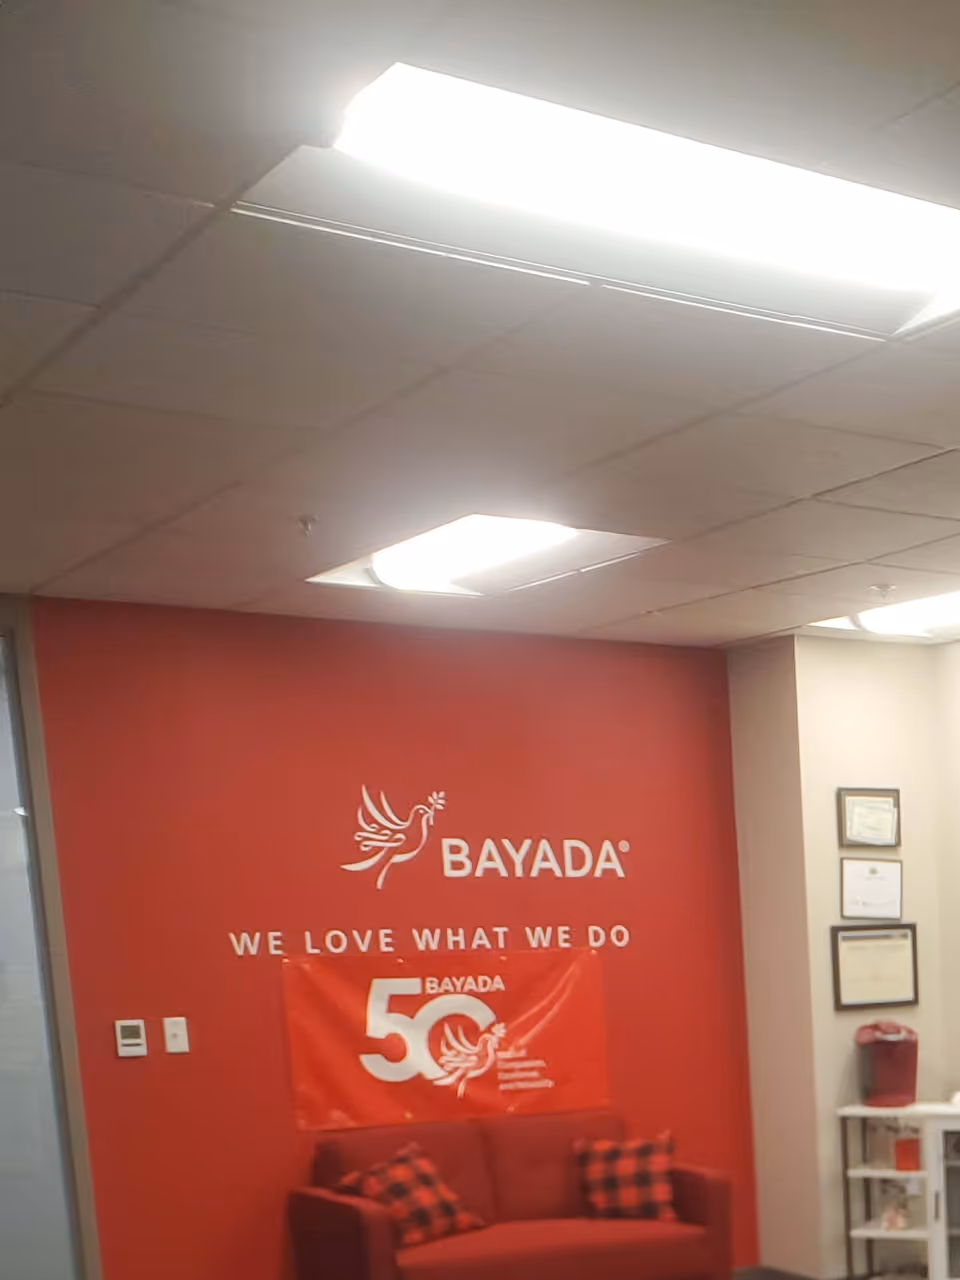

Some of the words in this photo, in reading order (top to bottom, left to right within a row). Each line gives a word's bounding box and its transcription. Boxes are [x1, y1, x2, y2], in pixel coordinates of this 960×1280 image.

[229, 931, 284, 956] WE
[304, 929, 395, 955] LOVE
[412, 926, 509, 951] WHAT
[525, 926, 571, 949] WE
[588, 925, 630, 948] DO
[424, 975, 506, 994] BAYADA
[359, 977, 498, 1082] 50
